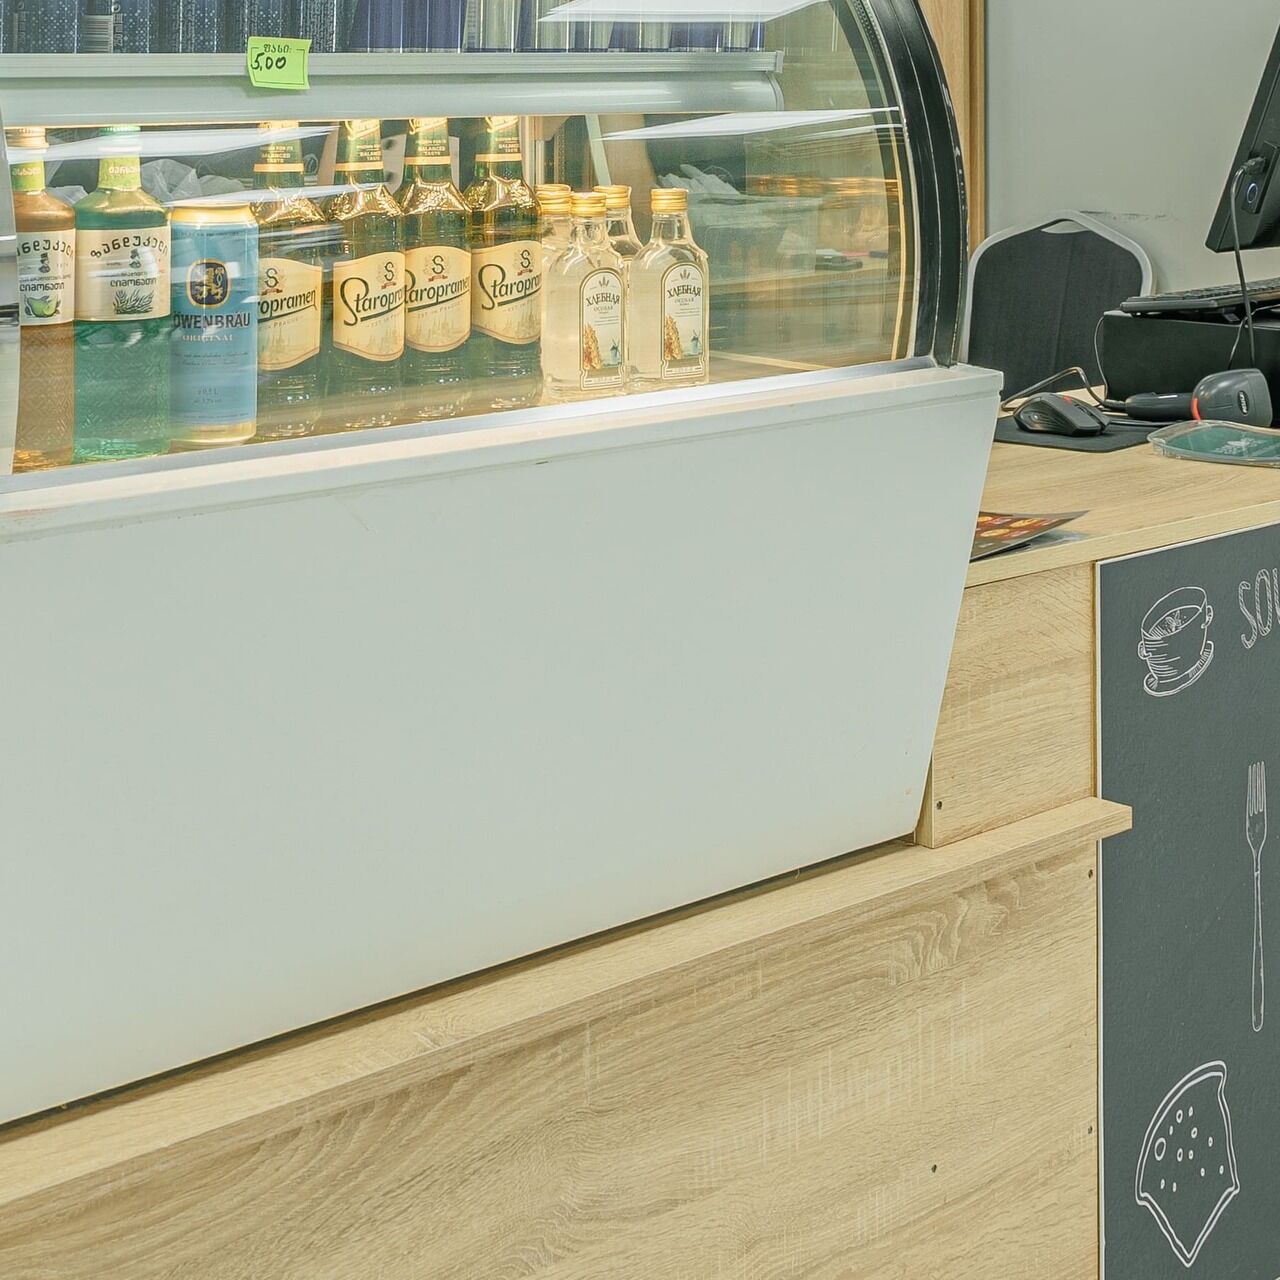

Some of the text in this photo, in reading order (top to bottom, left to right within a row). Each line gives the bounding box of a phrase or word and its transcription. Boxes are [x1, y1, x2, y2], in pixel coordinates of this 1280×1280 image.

[667, 284, 702, 299] ХЛЕБНАЯ
[586, 292, 621, 307] ХЛЕБНАЯ
[173, 312, 251, 329] ÖWENBRÄU
